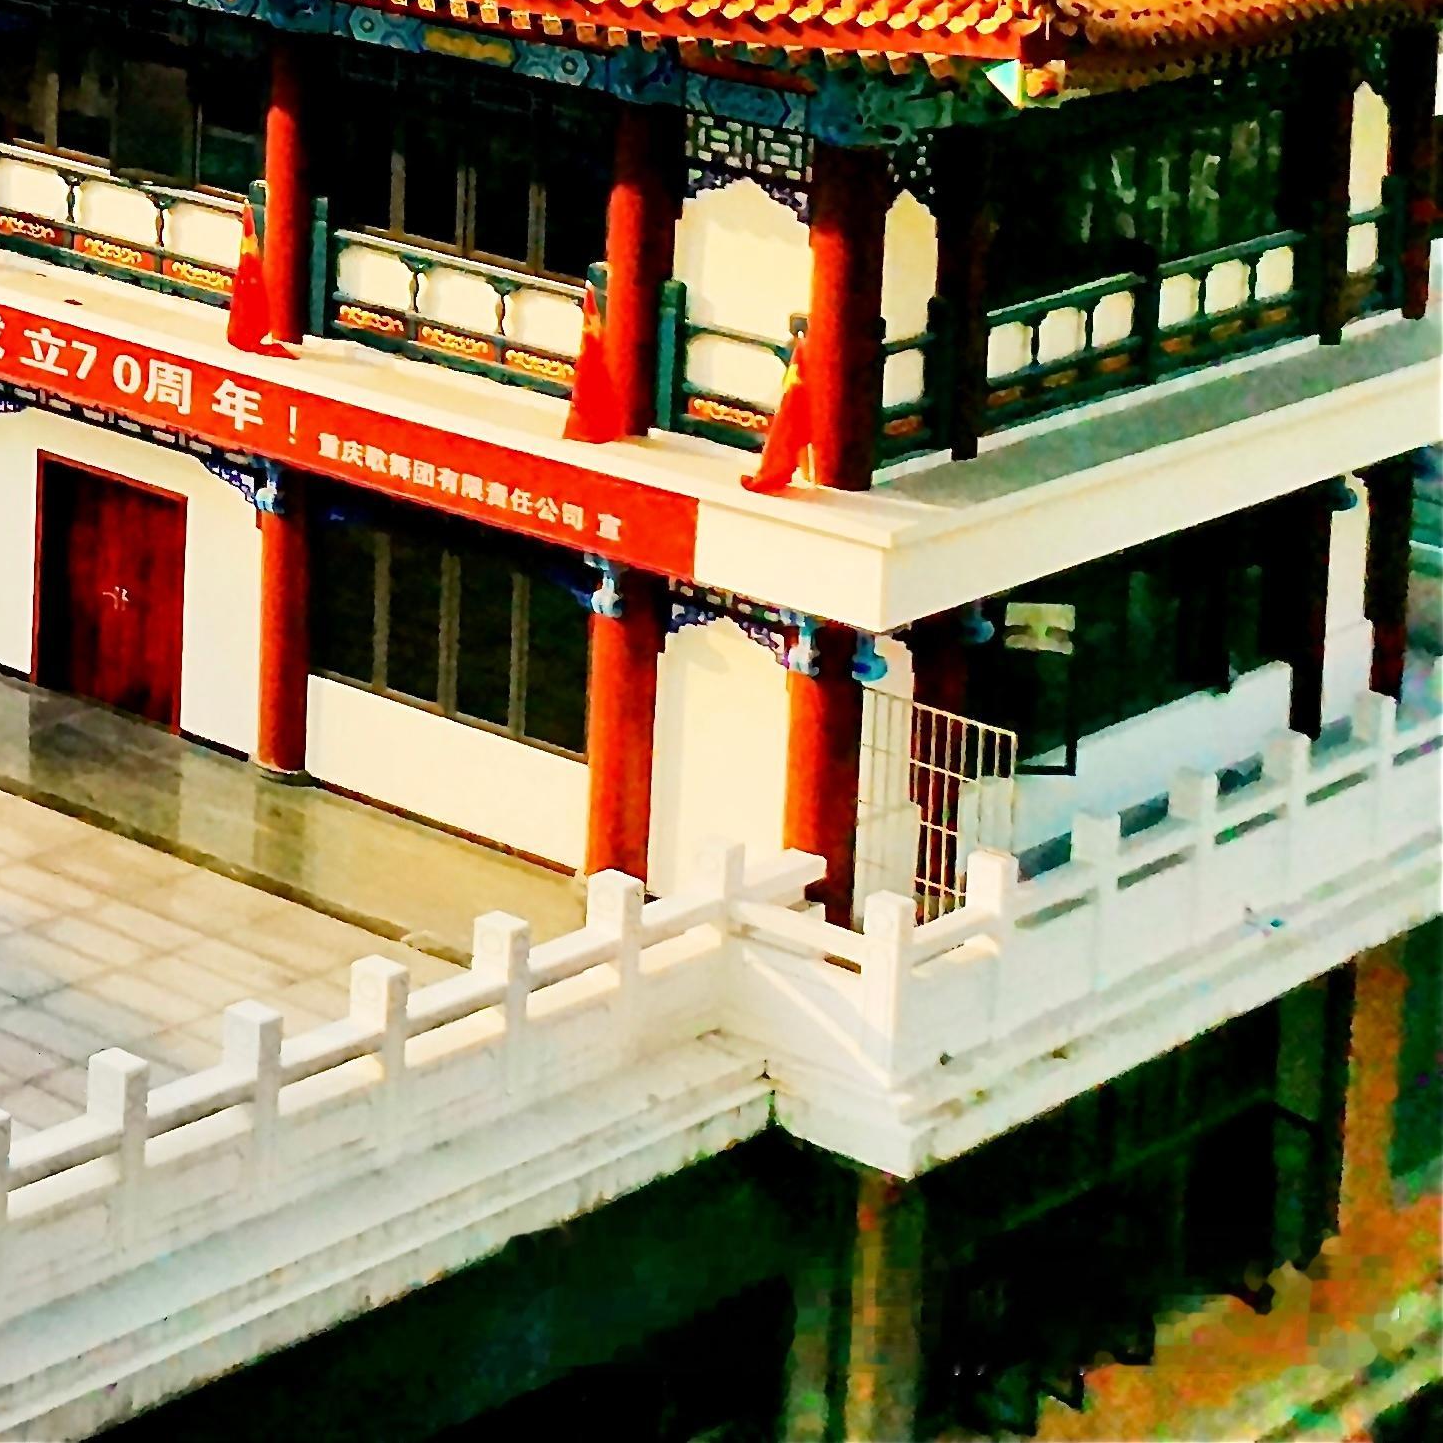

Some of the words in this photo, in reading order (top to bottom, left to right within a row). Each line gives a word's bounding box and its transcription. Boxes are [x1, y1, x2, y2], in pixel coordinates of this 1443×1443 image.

[318, 432, 584, 531] 重庆歌舞团有限责任公司
[596, 513, 622, 542] 宣
